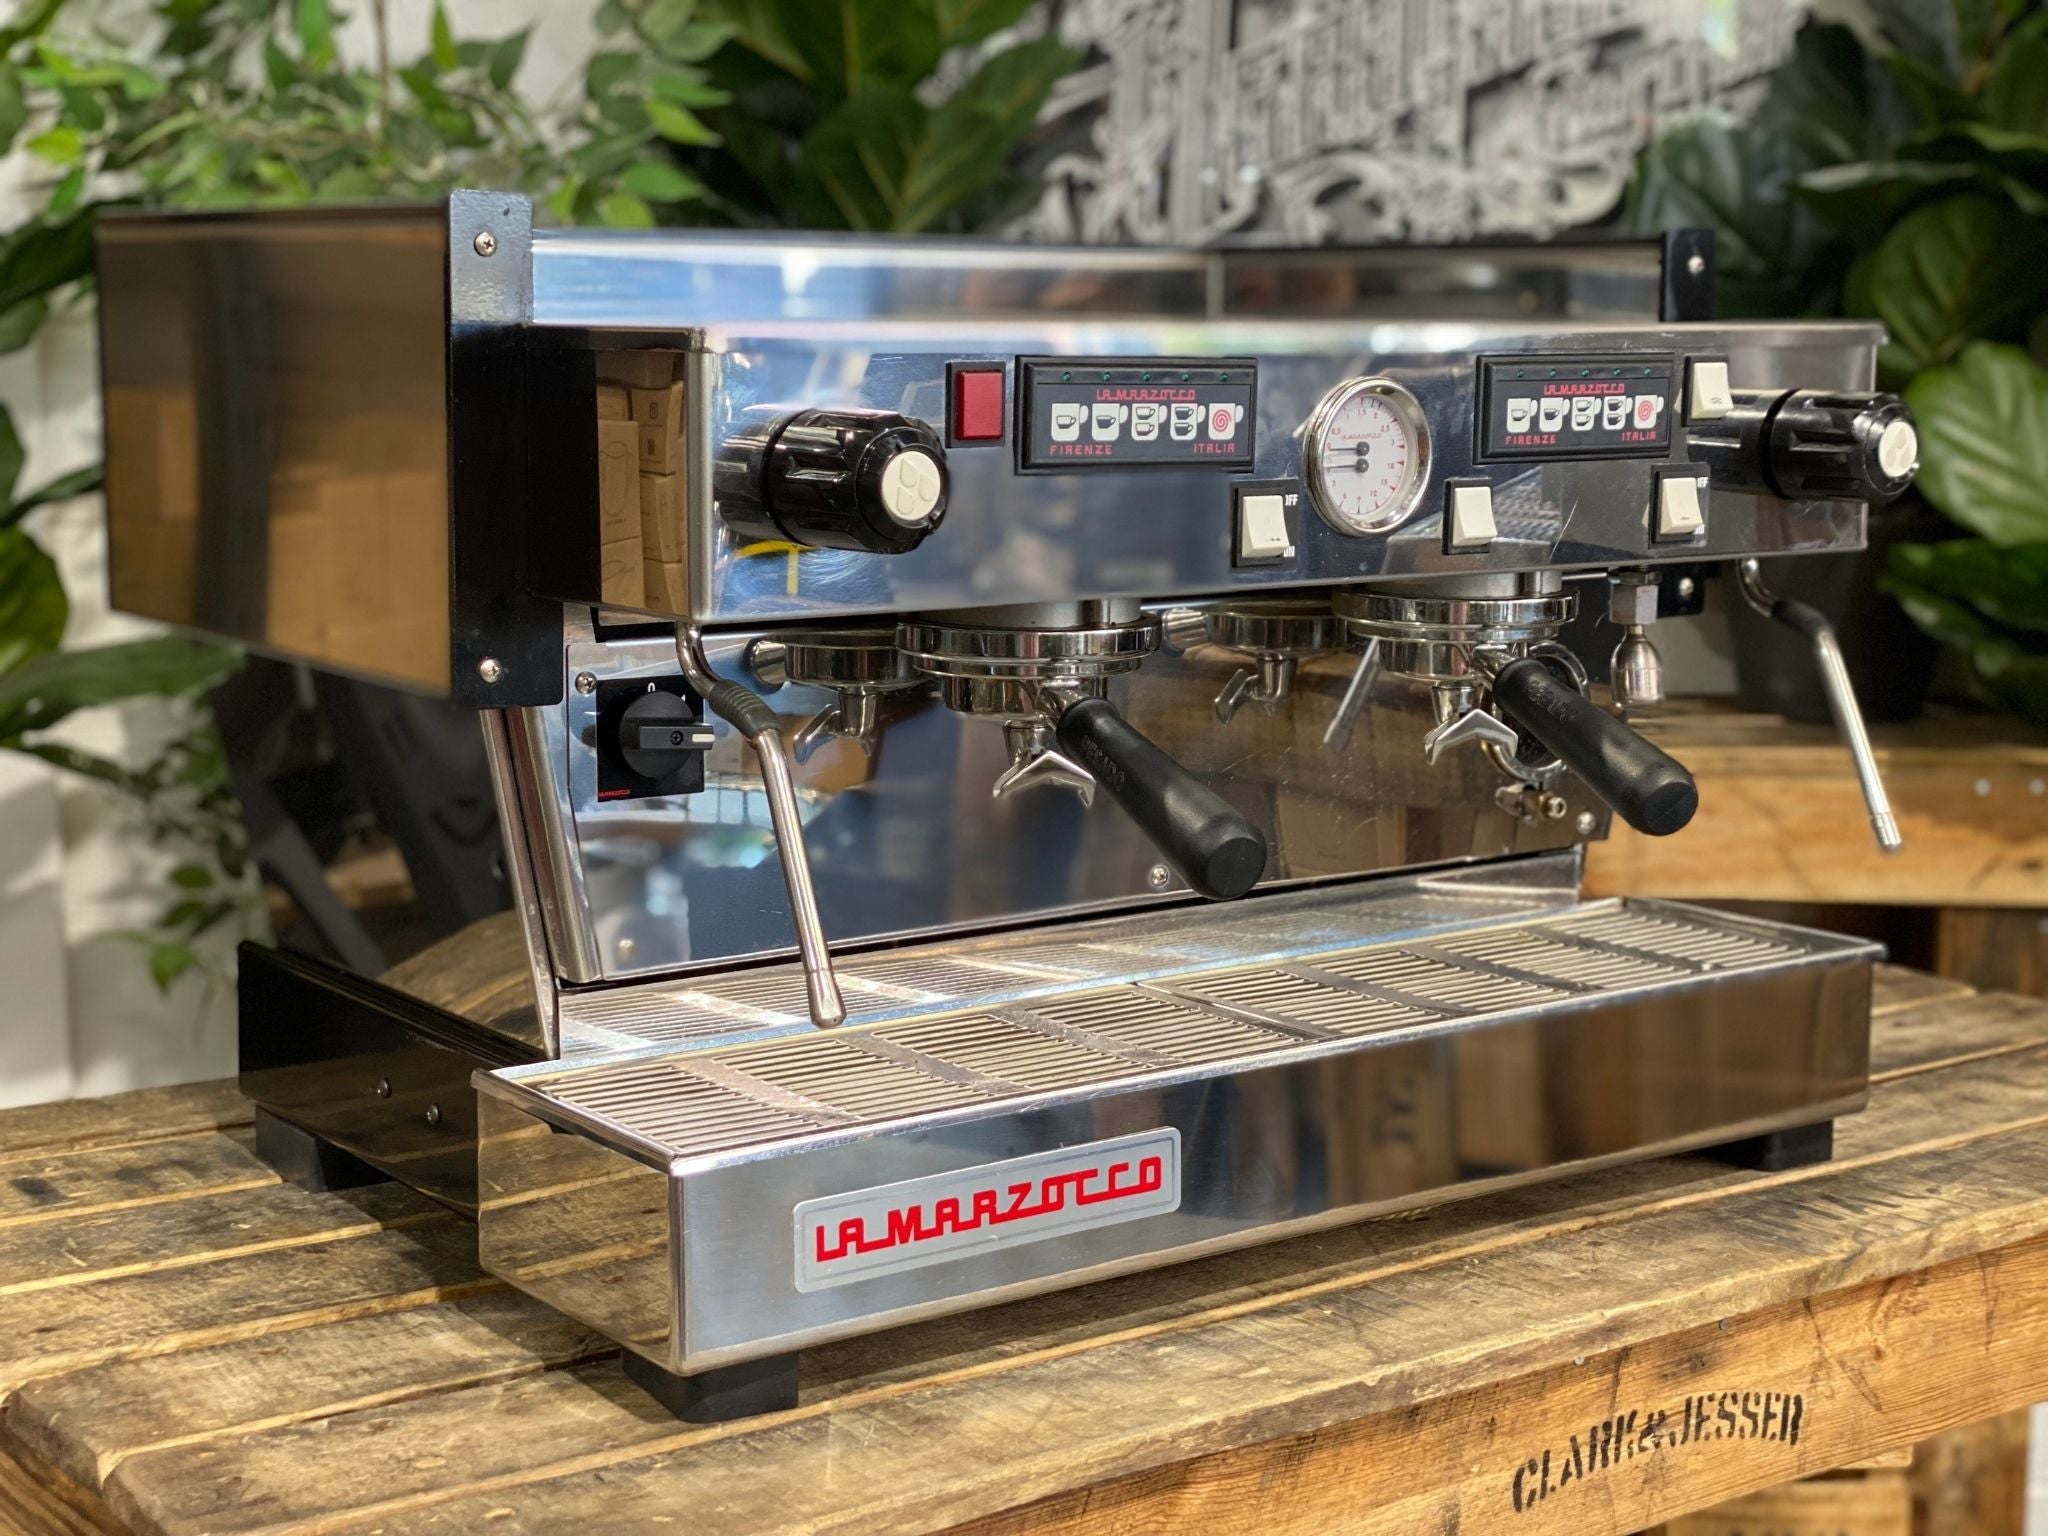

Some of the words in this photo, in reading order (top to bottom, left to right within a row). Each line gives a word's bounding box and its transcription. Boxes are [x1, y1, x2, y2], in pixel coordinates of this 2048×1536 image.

[1096, 389, 1109, 400] LA
[1117, 389, 1195, 400] MARZOCCO
[1544, 385, 1555, 395] LA
[1560, 383, 1625, 394] MARZOCCO
[1505, 435, 1556, 444] FIRENZE
[1622, 432, 1656, 441] ITALIA
[1050, 445, 1112, 455] FIRENZE
[1194, 443, 1235, 453] ITALIA
[816, 1217, 864, 1263] LA
[887, 1156, 1162, 1245] MARZOCCO
